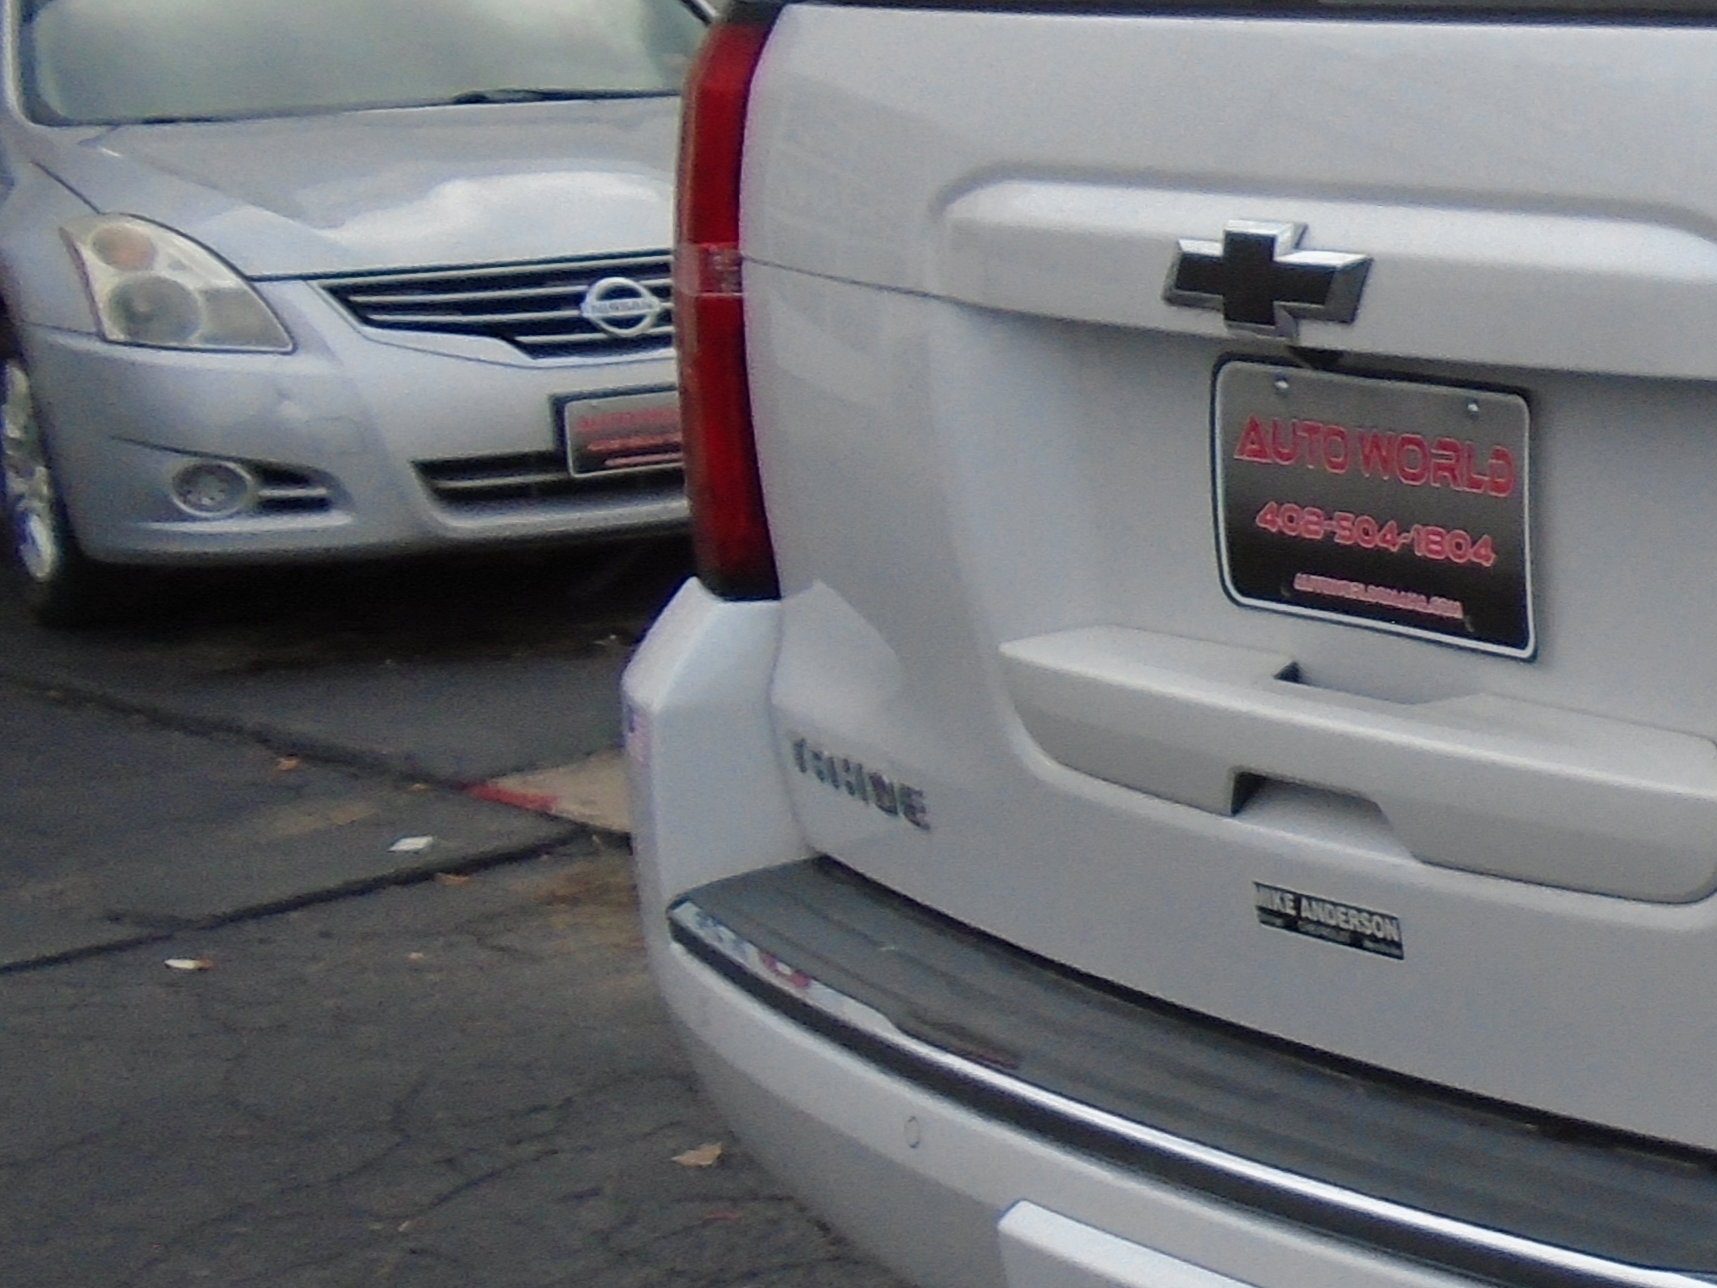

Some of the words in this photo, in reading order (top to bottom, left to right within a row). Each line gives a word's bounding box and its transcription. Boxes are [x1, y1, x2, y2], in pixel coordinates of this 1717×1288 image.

[1234, 414, 1349, 474] AUTO
[1357, 427, 1515, 497] WORLD
[1256, 500, 1496, 567] 402-504-1804
[1300, 898, 1400, 943] ANDERSON
